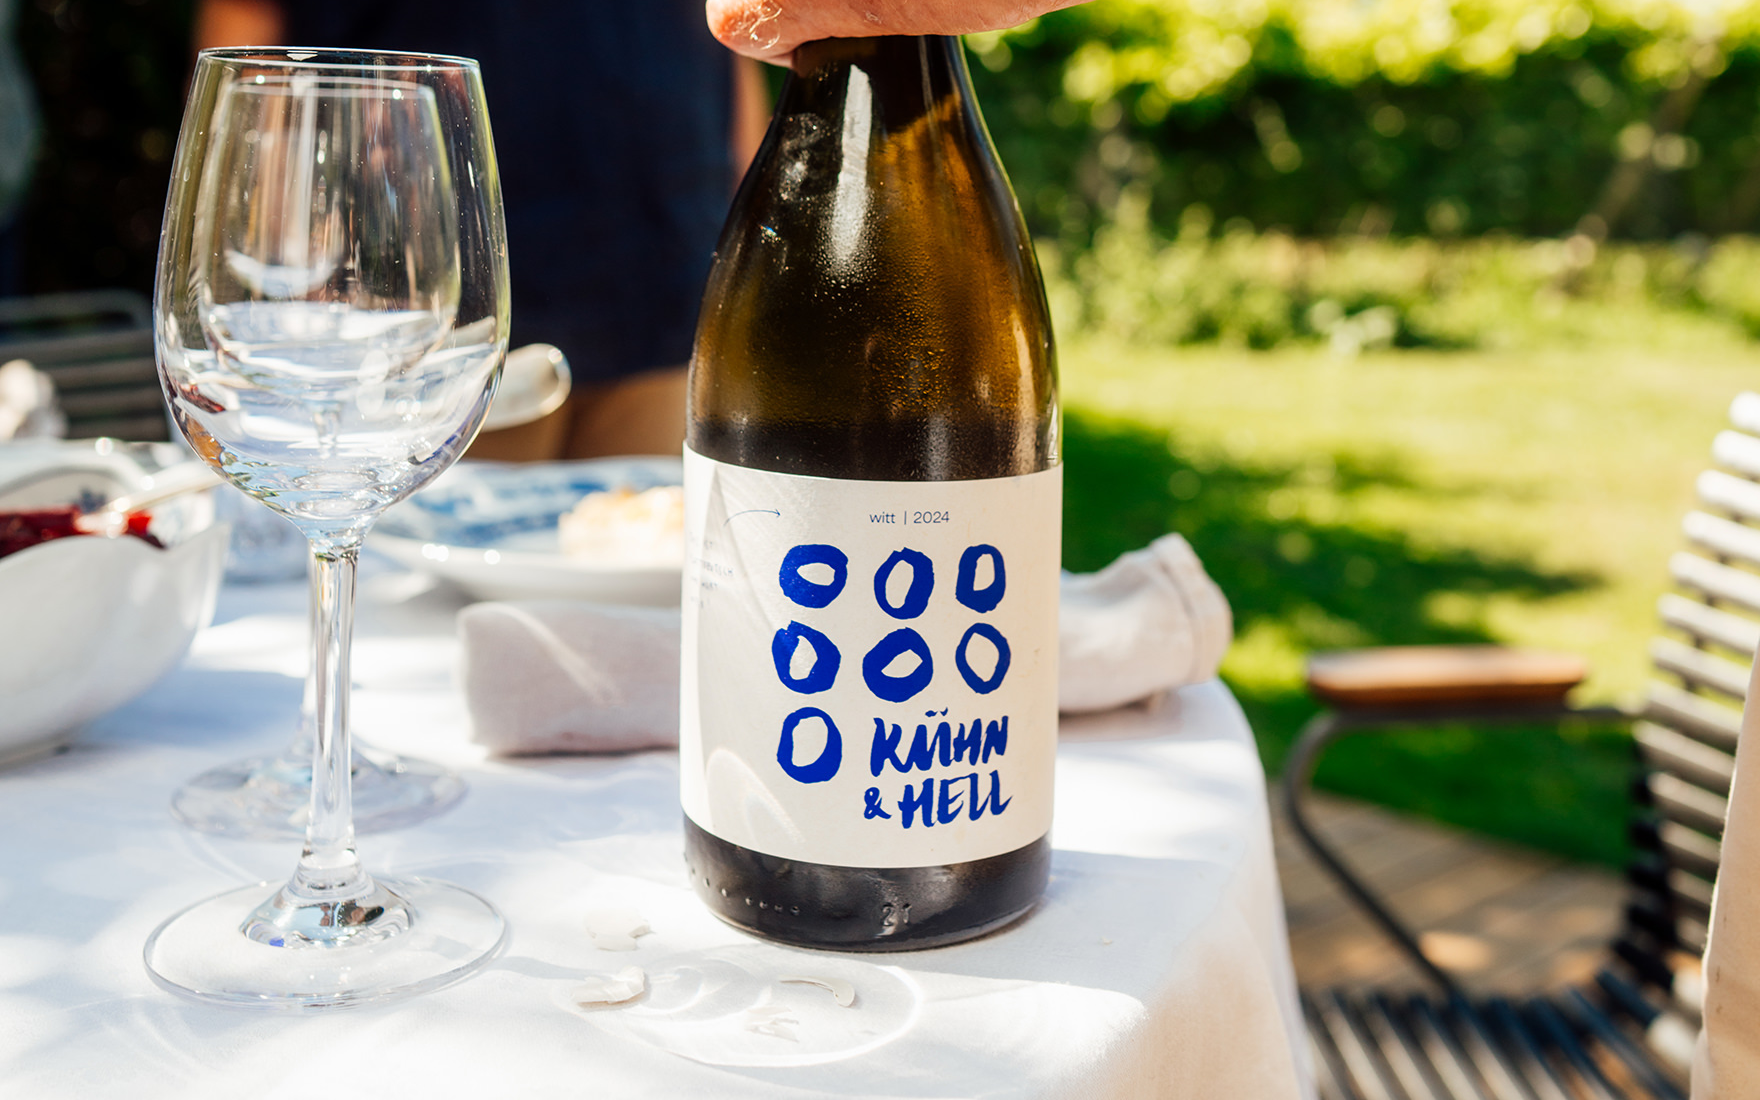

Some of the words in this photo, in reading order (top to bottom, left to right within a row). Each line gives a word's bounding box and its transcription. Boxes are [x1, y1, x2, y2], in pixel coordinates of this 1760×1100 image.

[869, 511, 896, 524] witt
[913, 511, 950, 524] 2024
[863, 786, 893, 820] &
[897, 769, 1014, 830] HELL
